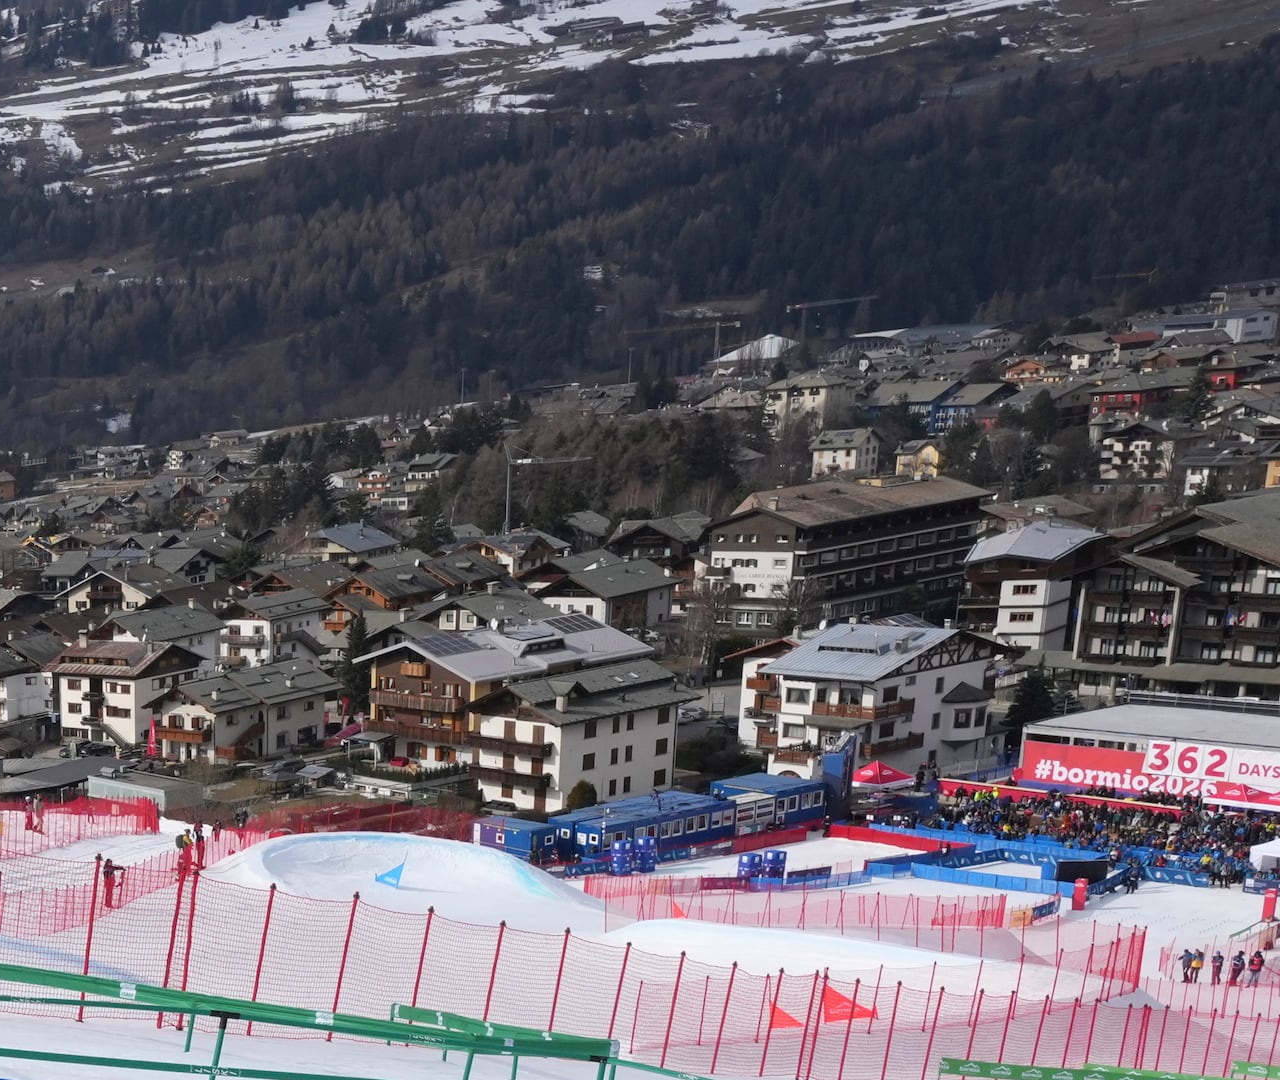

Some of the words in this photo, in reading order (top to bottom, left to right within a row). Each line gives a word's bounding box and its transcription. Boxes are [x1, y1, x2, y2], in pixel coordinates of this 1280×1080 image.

[1035, 758, 1218, 797] #bormio2026
[1148, 743, 1227, 778] 362
[1238, 762, 1280, 778] DAYS
